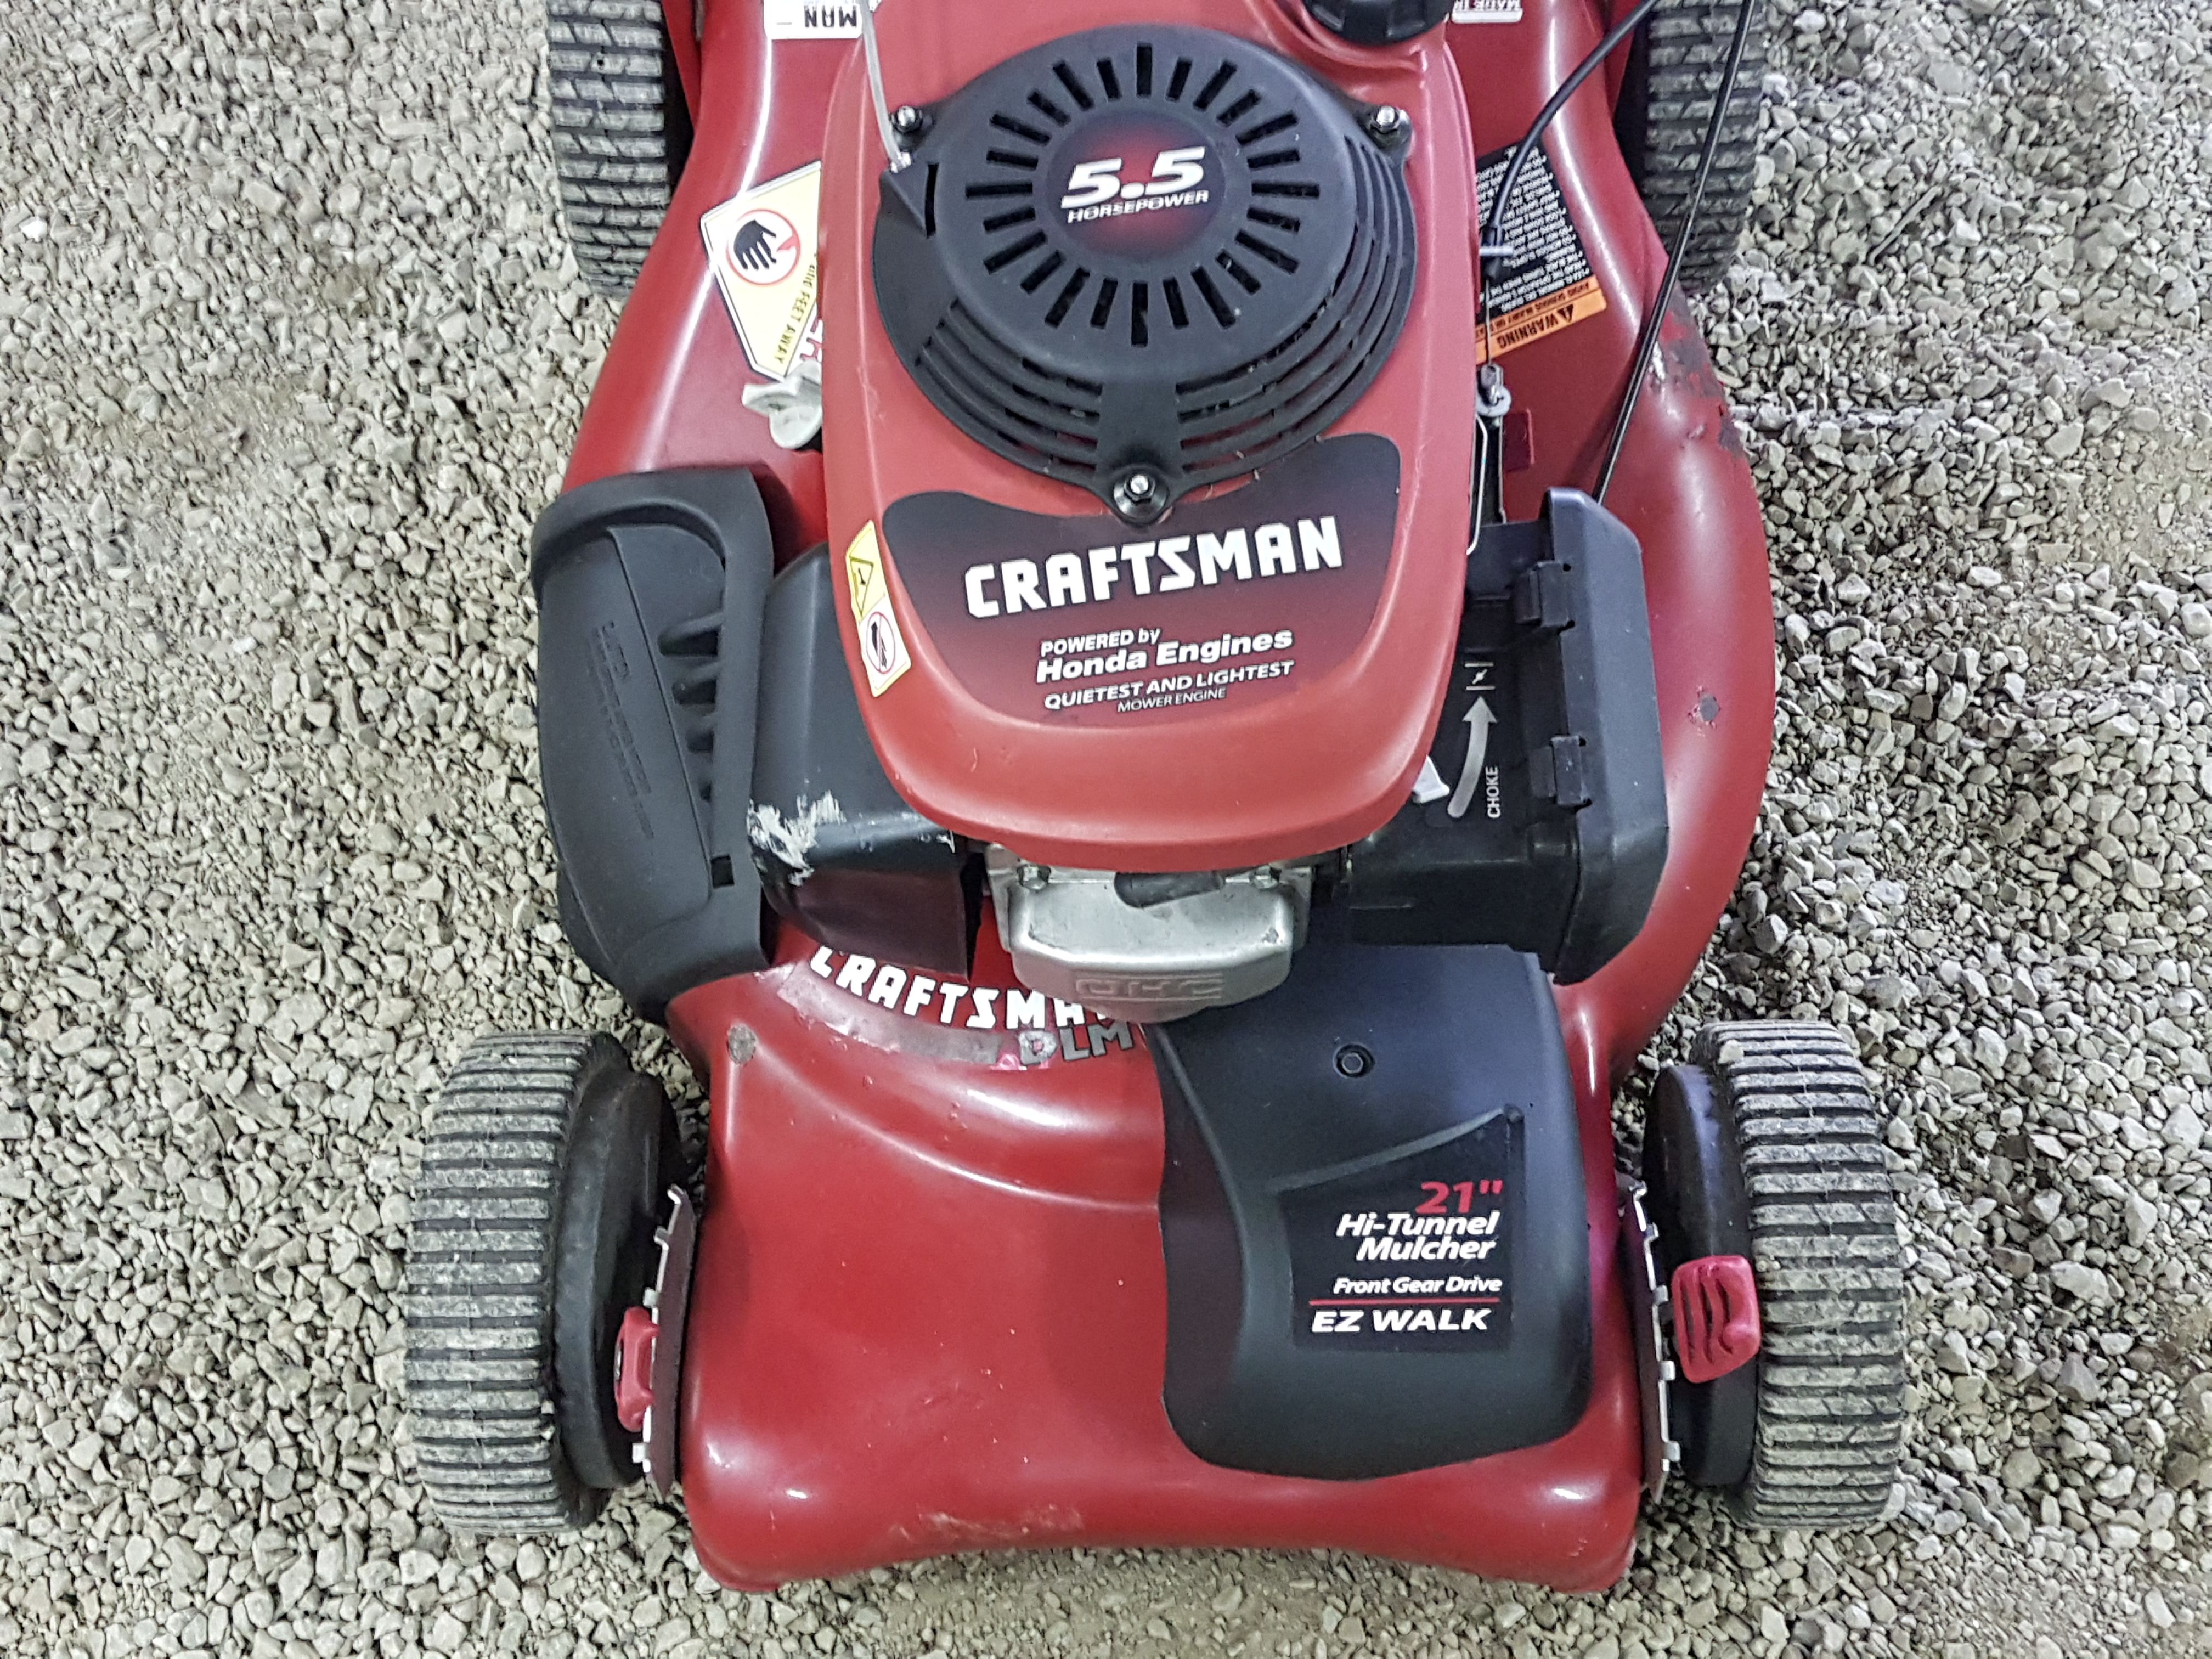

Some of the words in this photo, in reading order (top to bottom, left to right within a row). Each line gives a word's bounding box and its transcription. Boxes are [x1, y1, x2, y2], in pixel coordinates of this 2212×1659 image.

[1061, 146, 1205, 208] 5.5
[1068, 190, 1209, 224] HORSEPOWER
[791, 291, 810, 322] FEET
[775, 324, 795, 364] AWAY
[1497, 312, 1558, 349] WARNING
[964, 516, 1342, 618] CRAFTSMAN
[1036, 649, 1147, 683] Honda
[1156, 630, 1293, 665] Engines
[1041, 630, 1134, 657] POWERED
[1138, 628, 1160, 644] by
[1045, 681, 1144, 709] QUIETEST
[1147, 676, 1192, 694] AND
[1197, 660, 1295, 687] LIGHTEST
[1117, 695, 1172, 713] MOWER
[1175, 687, 1227, 704] ENGINE
[1486, 766, 1500, 818] CHOKE
[810, 945, 1106, 1030] CRAFTSMA
[1415, 1180, 1503, 1214] 21"
[1336, 1210, 1500, 1237] Hi-Tunnel
[1356, 1235, 1496, 1261] Mulcher
[1333, 1277, 1390, 1294] Front
[1393, 1277, 1444, 1293] Gear
[1445, 1276, 1503, 1293] Drive
[1312, 1310, 1364, 1332] EZ
[1372, 1308, 1492, 1331] WALK
